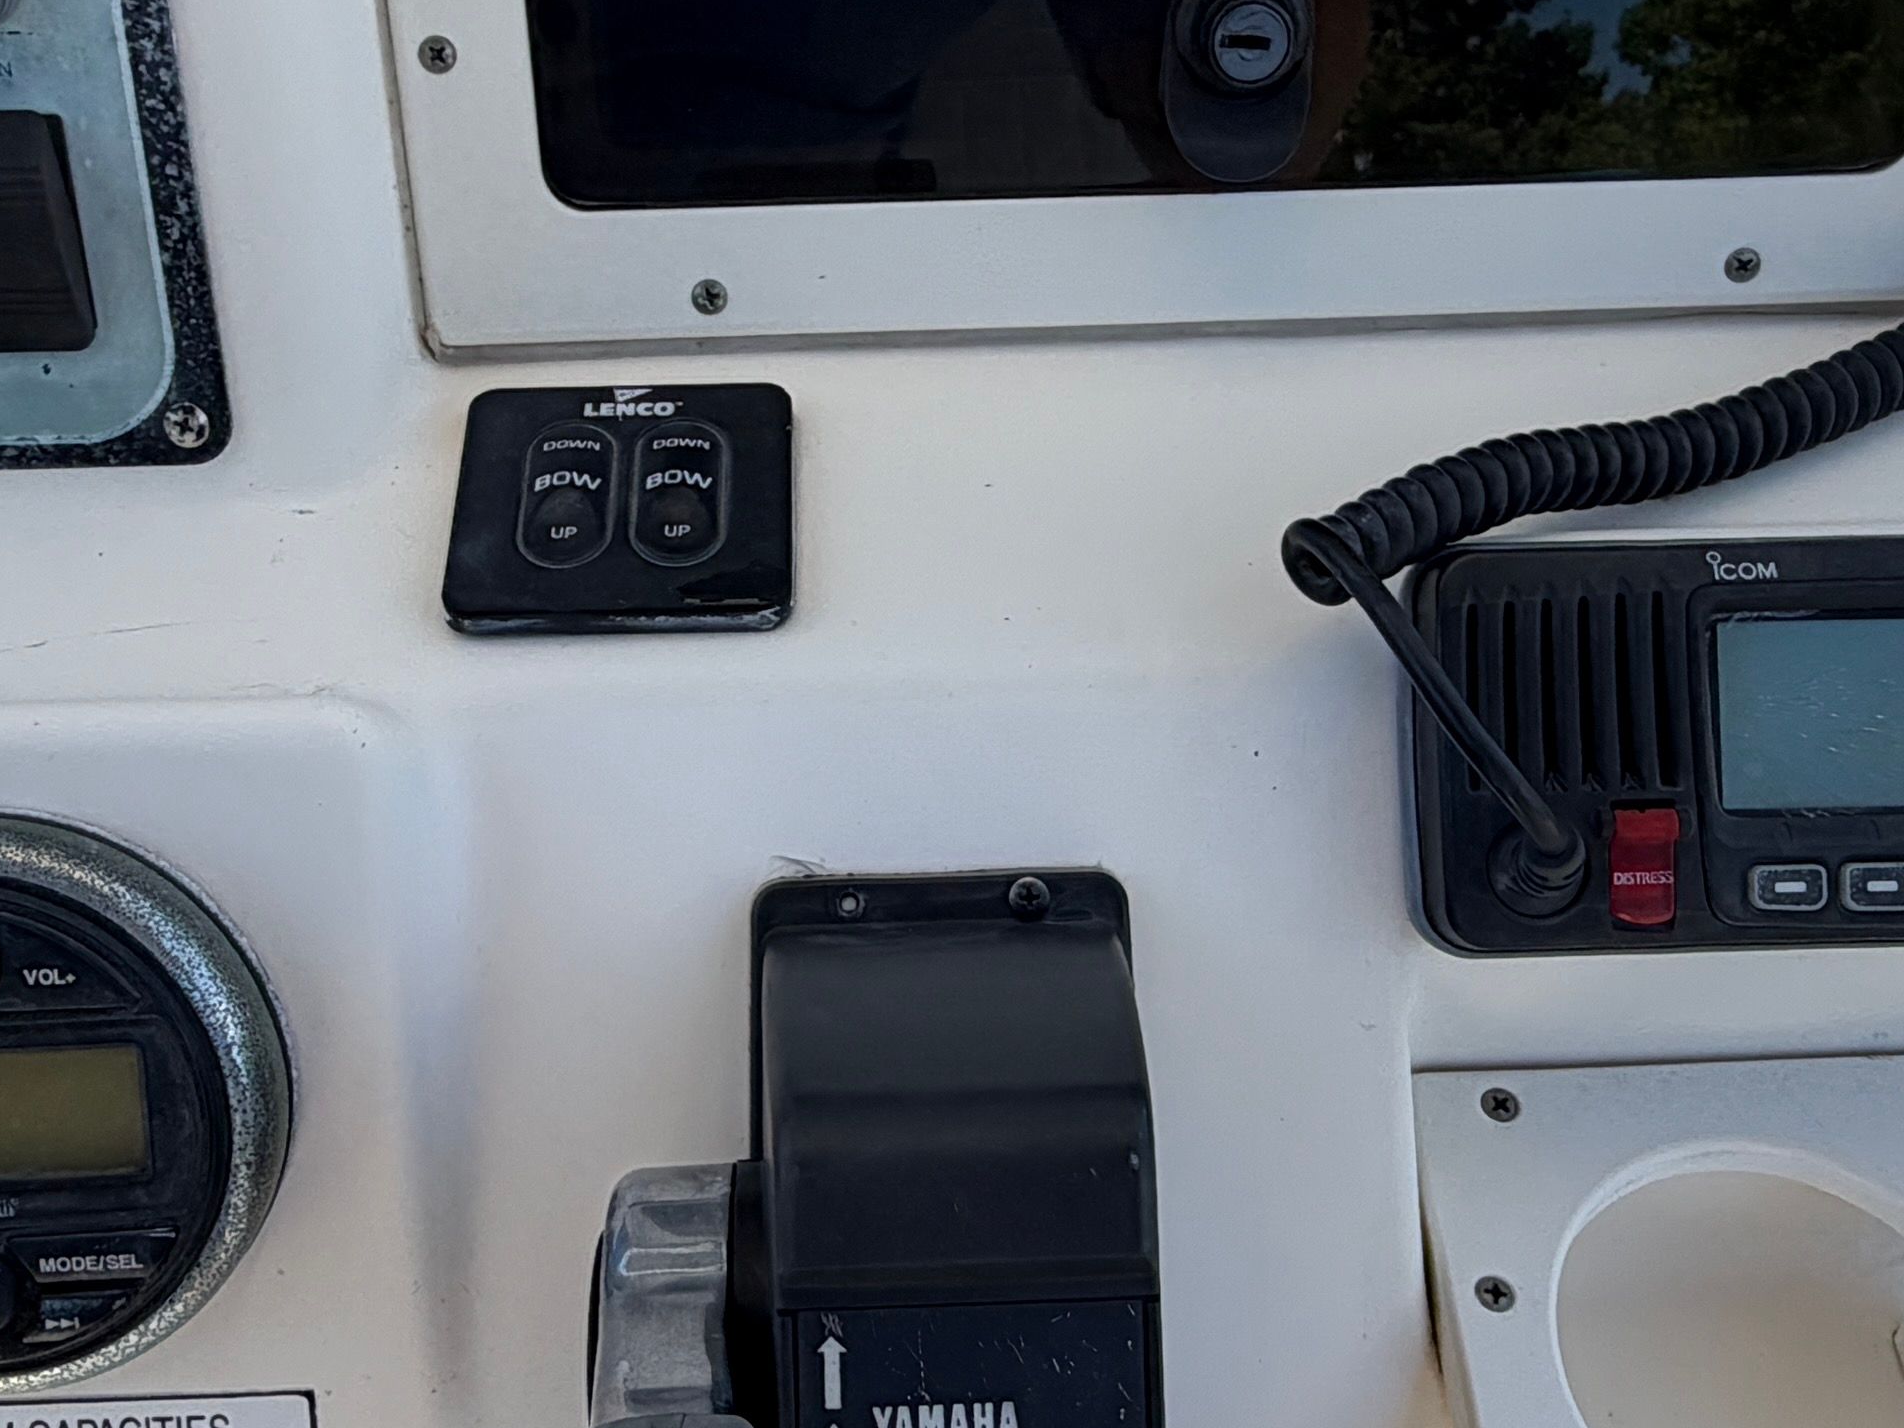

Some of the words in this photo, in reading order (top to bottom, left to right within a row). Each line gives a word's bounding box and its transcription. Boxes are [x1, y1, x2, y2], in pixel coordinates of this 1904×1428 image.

[542, 440, 600, 452] DOWN
[652, 438, 710, 451] DOWN
[533, 471, 601, 493] BOW
[645, 470, 713, 491] BOW
[550, 526, 578, 539] UP
[663, 524, 691, 538] UP
[1613, 871, 1674, 885] DISTRESS
[23, 969, 77, 985] VOL+
[39, 1254, 144, 1273] MODE/SEL
